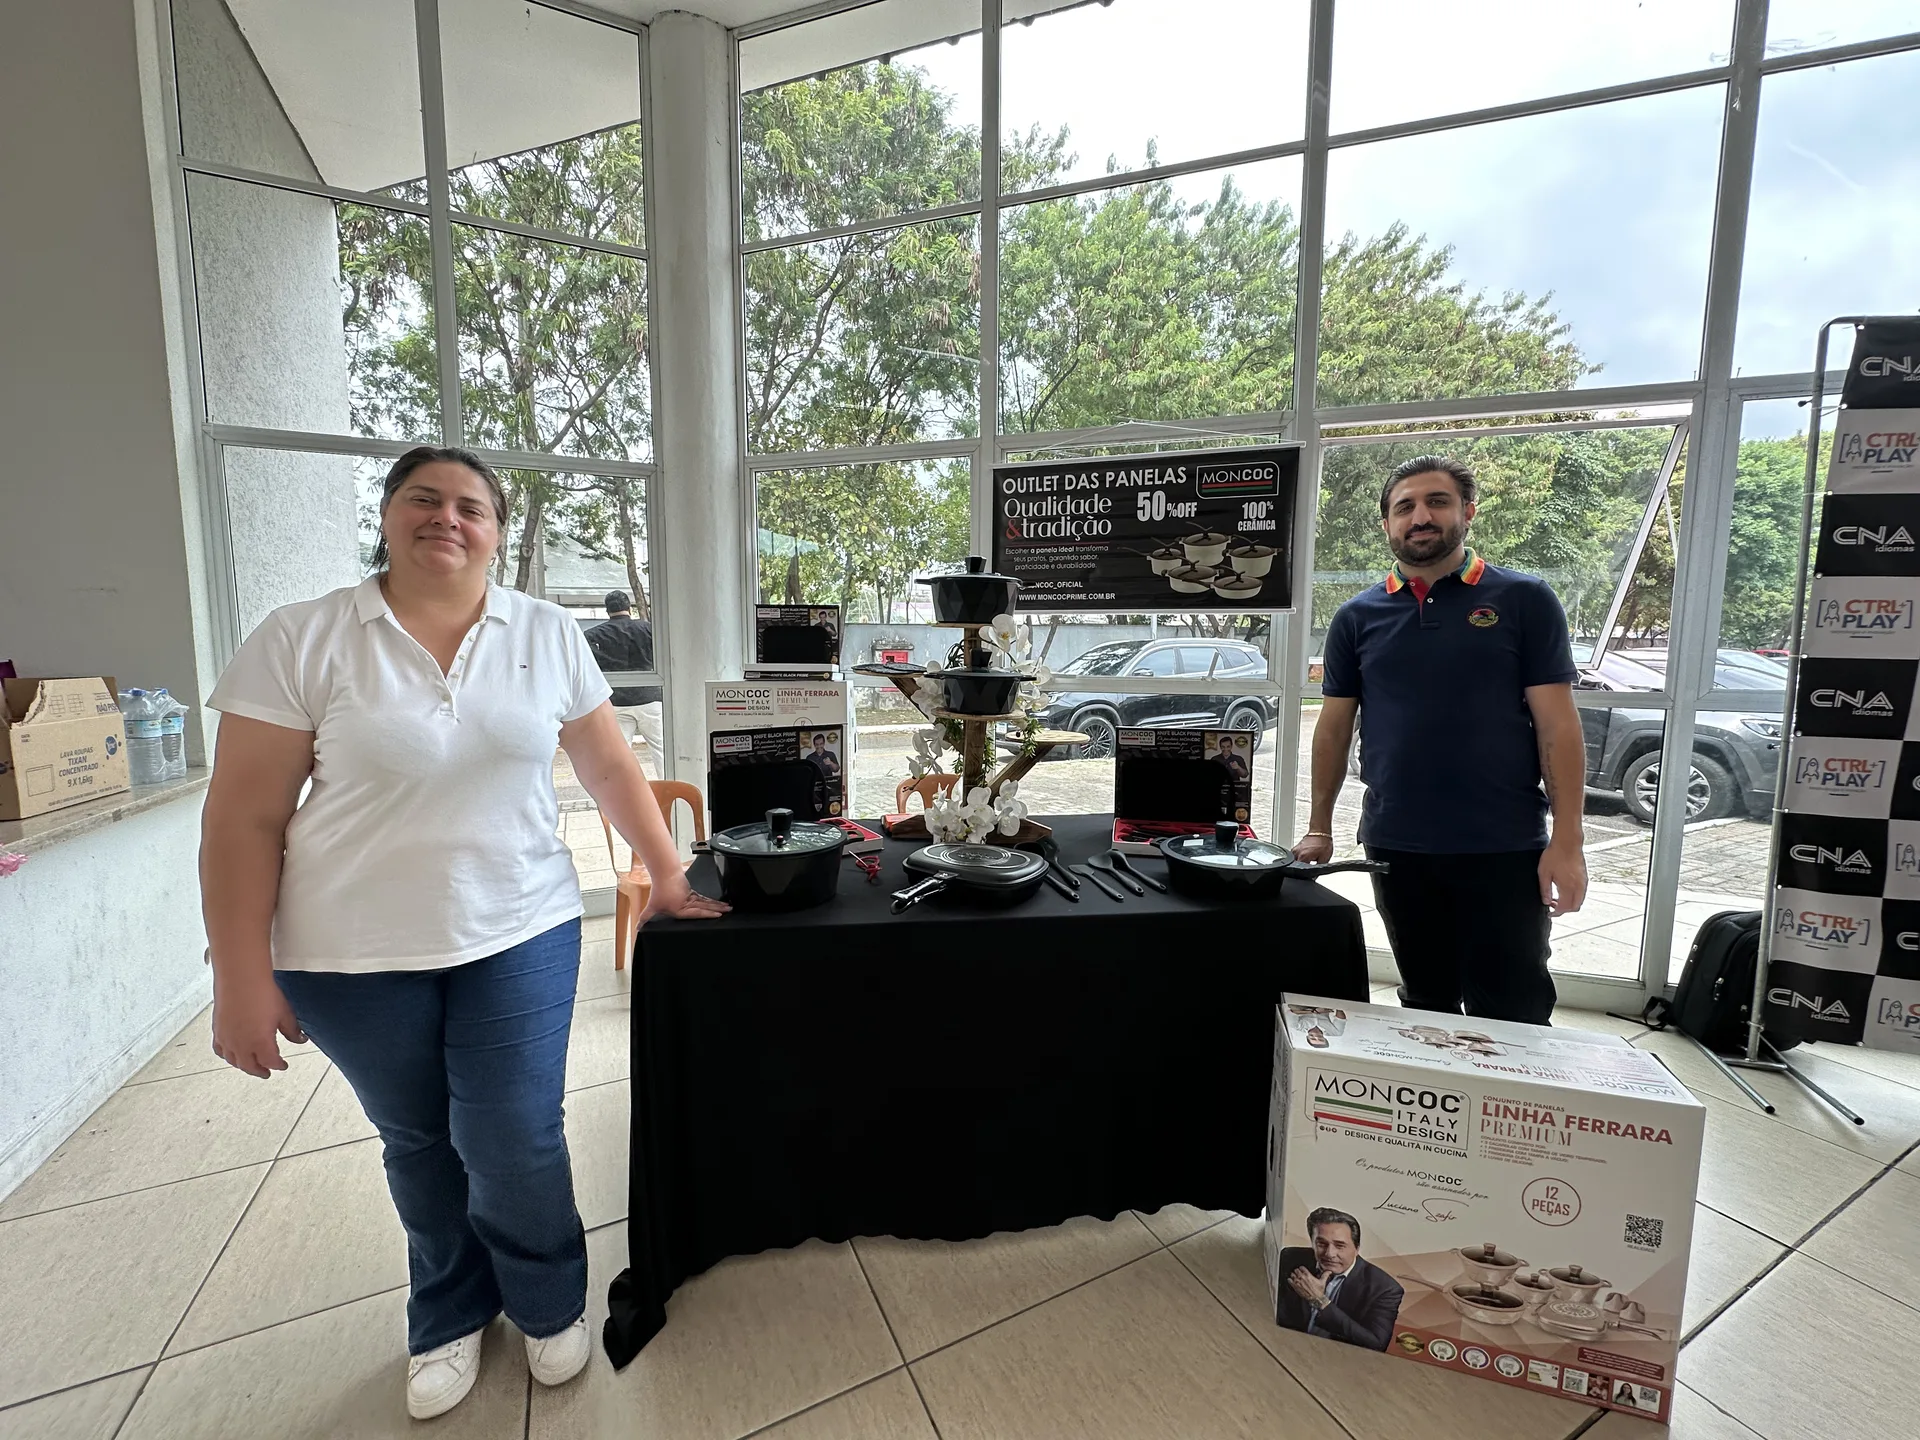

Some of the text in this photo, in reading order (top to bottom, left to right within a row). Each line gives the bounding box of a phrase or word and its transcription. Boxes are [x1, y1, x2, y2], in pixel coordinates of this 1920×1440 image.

[1863, 448, 1918, 463] PLAY
[1002, 466, 1187, 494] OUTLET DAS PANELAS
[1201, 468, 1274, 484] MONCOC
[1004, 493, 1112, 518] Qualidade
[1241, 501, 1274, 519] 100%
[1832, 525, 1915, 545] CNA
[1005, 547, 1029, 555] Escolher
[1036, 547, 1057, 555] panela
[1058, 545, 1074, 553] ideal
[1076, 544, 1109, 552] transforma
[1875, 544, 1915, 552] idiomas
[1014, 563, 1049, 571] praticidade
[1018, 592, 1116, 601] WWW.MONCOCPRIME.COM.BR
[1841, 614, 1902, 629] PLAY
[716, 689, 770, 699] MONCOC
[1810, 689, 1894, 709] CNA
[1852, 708, 1893, 717] idiomas
[715, 736, 750, 744] MONCOC
[60, 747, 93, 758] LAVA ROUPAS
[68, 755, 87, 766] TIXAN
[59, 763, 98, 777] CONCENTRADO
[67, 775, 93, 787] 9 X 1,6kg
[1821, 772, 1871, 788] PLAY
[1789, 844, 1872, 868] CNA
[1834, 865, 1872, 874] idiomas
[1796, 924, 1857, 944] PLAY
[1767, 988, 1850, 1018] CNA
[1810, 1012, 1850, 1024] idiomas
[1472, 1062, 1531, 1076] FERRARA
[1314, 1074, 1461, 1114] MONCOC
[1593, 1080, 1676, 1097] MONCOC
[1483, 1095, 1522, 1106] CONJUNTO
[1534, 1102, 1565, 1112] PANELAS
[1397, 1109, 1459, 1130] ITALY
[1482, 1101, 1673, 1145] LINHA FERRARA
[1397, 1123, 1458, 1144] DESIGN
[1480, 1118, 1572, 1146] PREMIUM
[1344, 1129, 1376, 1142] DESIGN
[1377, 1135, 1383, 1143] E
[1384, 1137, 1421, 1150] QUALITÀ
[1433, 1146, 1468, 1159] CUCINA
[1355, 1157, 1463, 1186] Os produtos MONCOC
[1431, 1184, 1471, 1197] assinados
[1470, 1191, 1489, 1200] por
[1544, 1185, 1559, 1200] 12
[1531, 1198, 1571, 1216] PEÇAS
